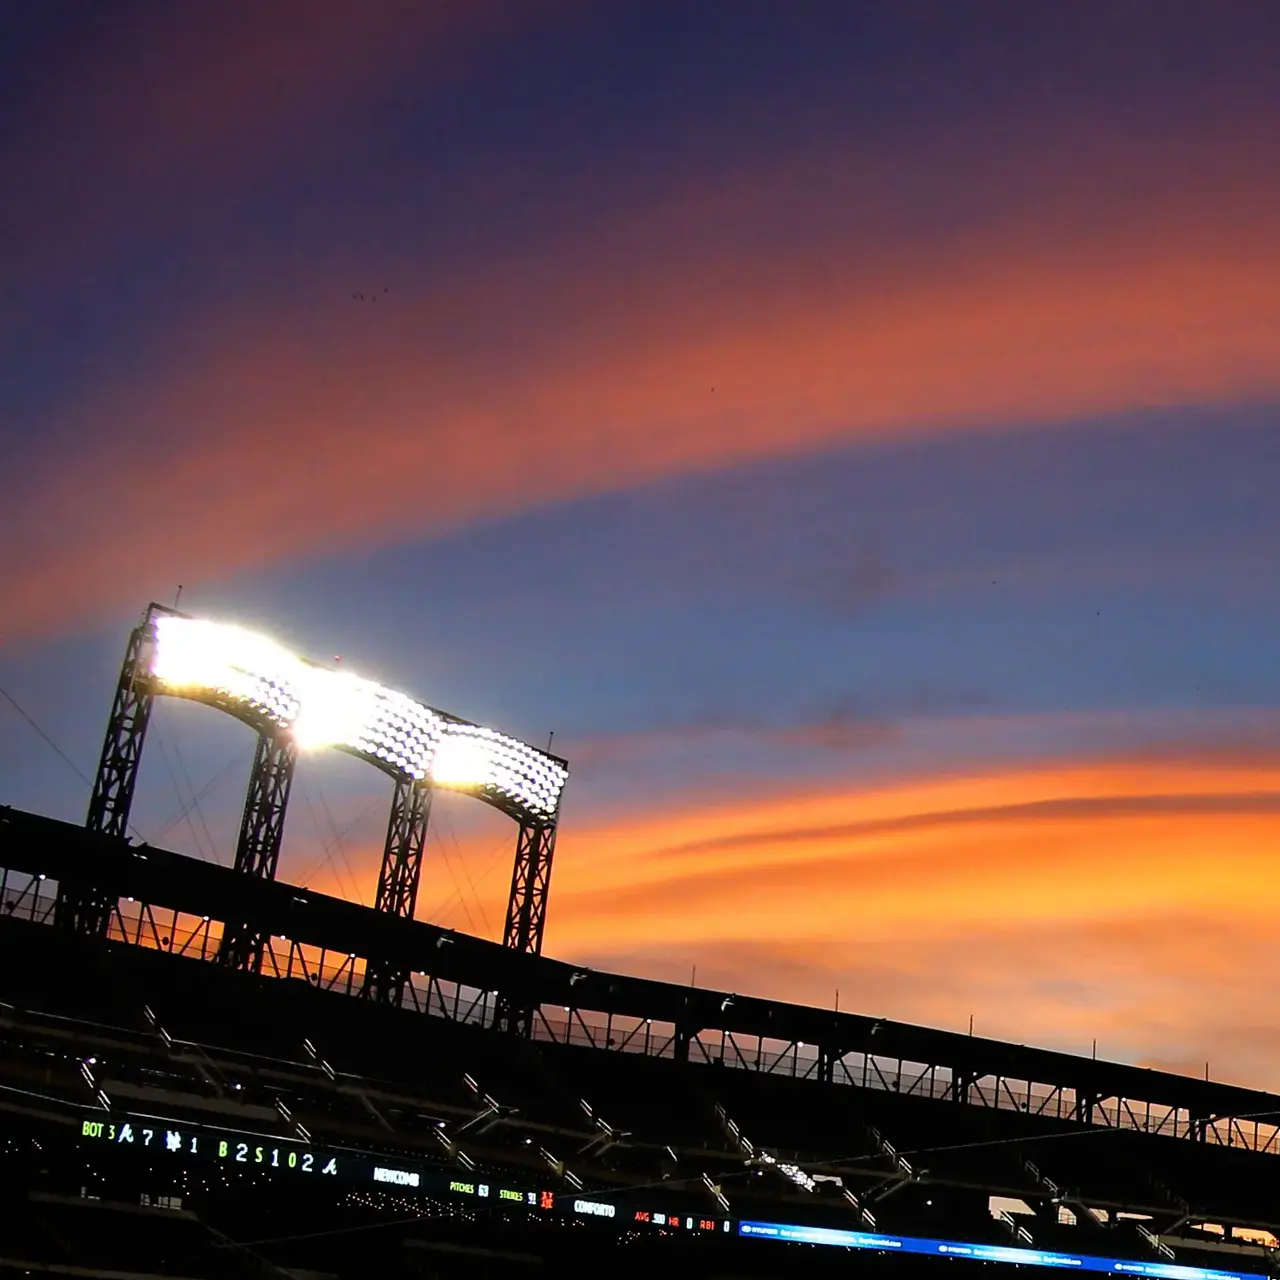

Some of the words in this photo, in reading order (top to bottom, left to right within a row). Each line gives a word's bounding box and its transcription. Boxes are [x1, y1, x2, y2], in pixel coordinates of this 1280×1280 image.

[82, 1120, 104, 1138] BOT
[107, 1123, 116, 1140] 3
[142, 1129, 154, 1147] 7
[190, 1136, 198, 1154] 1
[218, 1140, 228, 1157] B
[235, 1143, 248, 1162] 2
[255, 1146, 264, 1163] S
[271, 1149, 279, 1168] 1
[302, 1153, 313, 1172] 2
[373, 1166, 420, 1189] NEWCOMB
[449, 1180, 475, 1195] PITCHES
[499, 1188, 523, 1203] STRIKES
[574, 1199, 615, 1219] CONFORTO
[634, 1210, 650, 1225] AVG
[668, 1214, 680, 1228] HR
[700, 1218, 715, 1232] RBI
